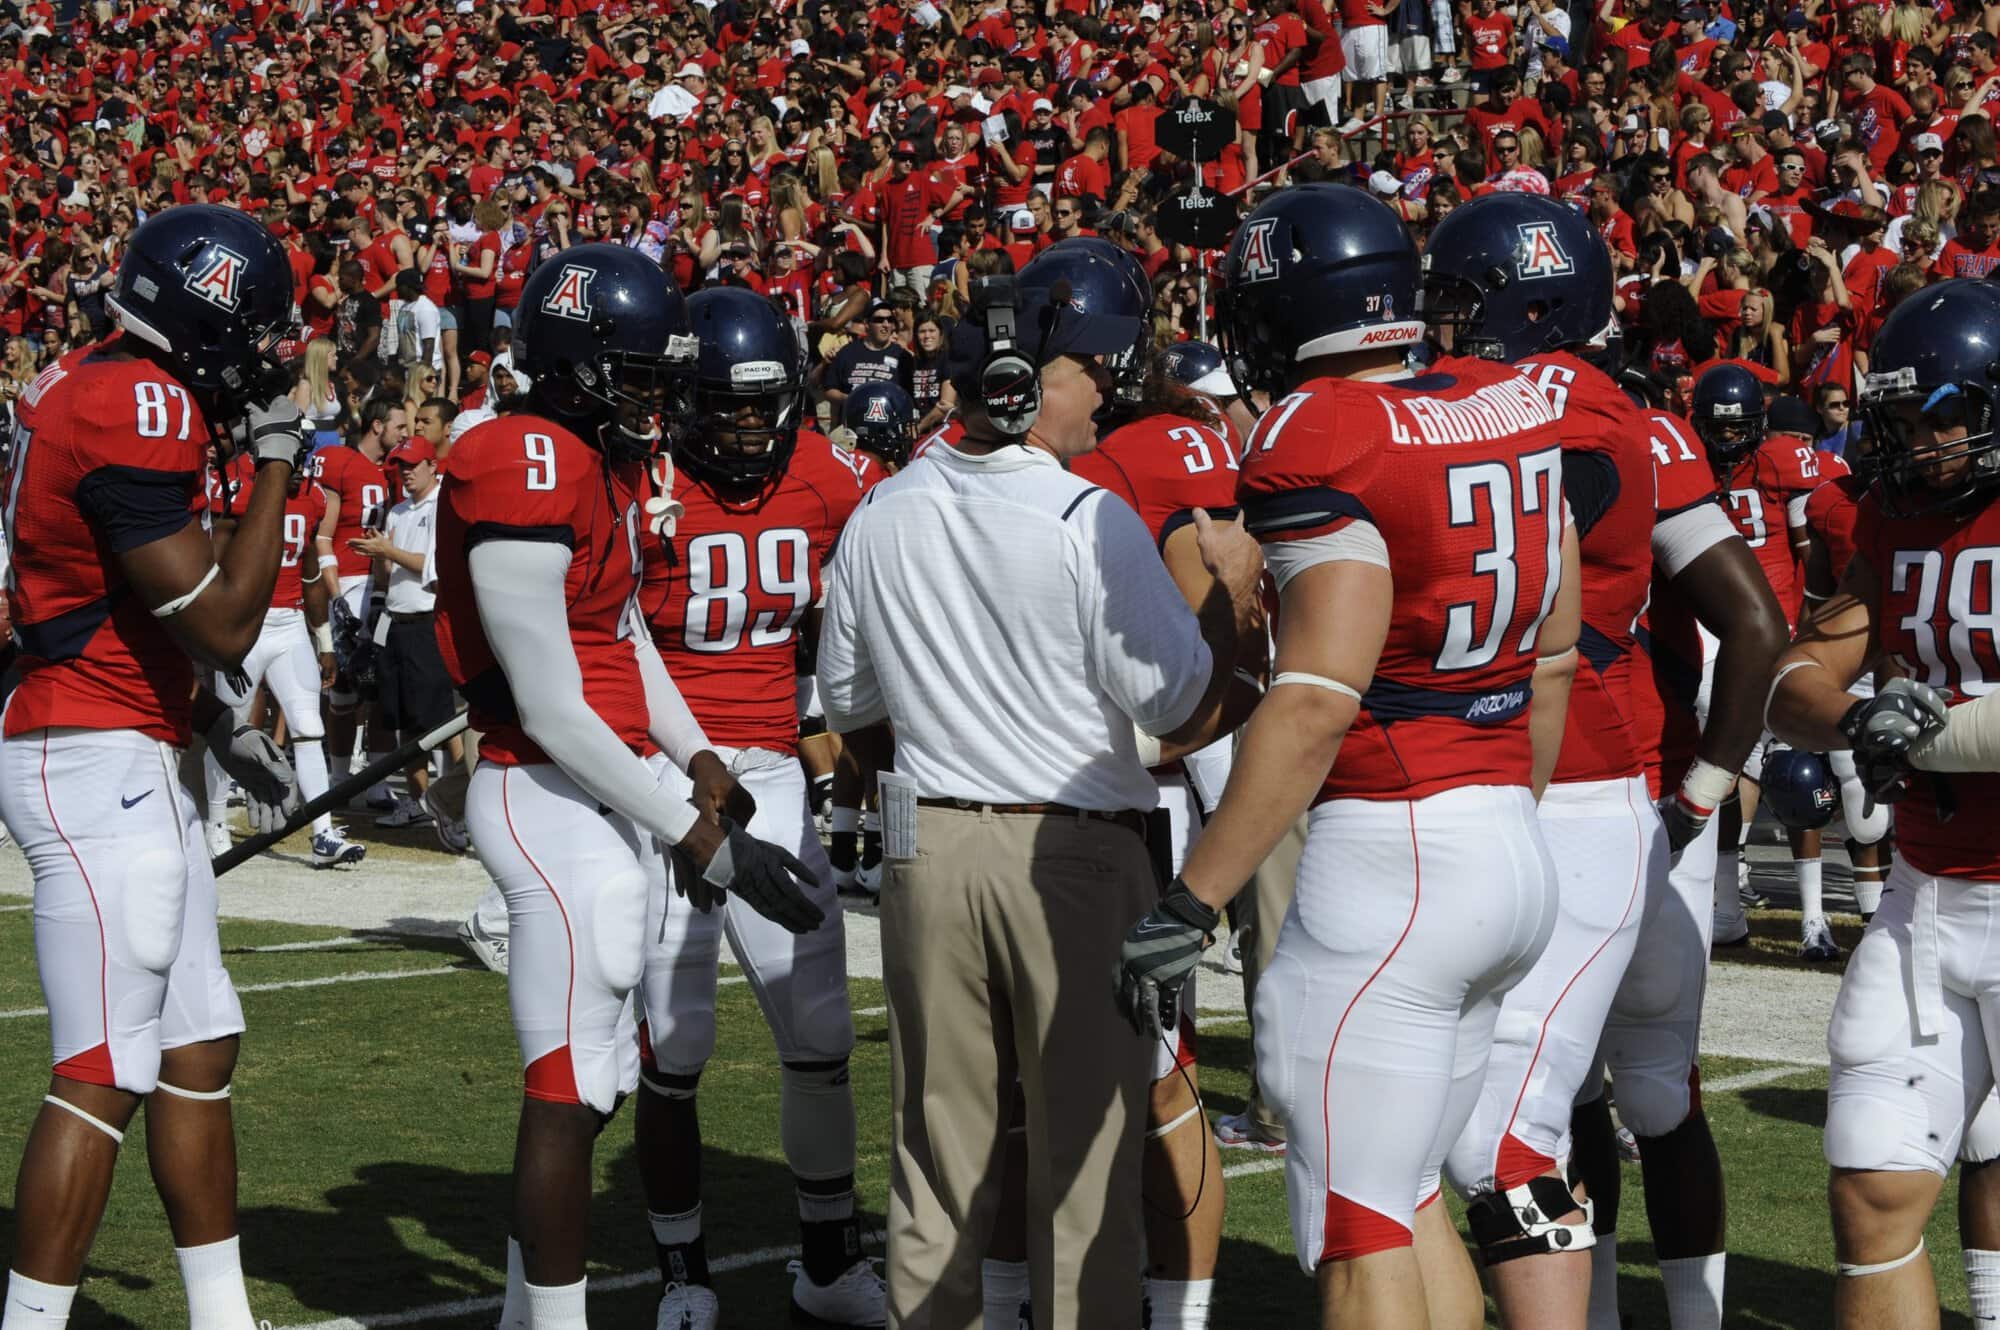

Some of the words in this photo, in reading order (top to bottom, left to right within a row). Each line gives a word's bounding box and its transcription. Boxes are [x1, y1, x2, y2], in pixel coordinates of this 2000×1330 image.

[1176, 110, 1213, 123] Telex
[1178, 196, 1214, 209] Telex
[184, 244, 248, 314] A
[1239, 217, 1280, 284] A
[1517, 221, 1575, 280] A
[541, 263, 597, 322] A
[1366, 296, 1380, 312] 37
[1359, 327, 1418, 345] ARIZONA
[134, 381, 191, 441] 87
[525, 434, 556, 490] 9
[1434, 448, 1562, 672] 37
[684, 528, 811, 654] 89
[1892, 548, 2000, 698] 38
[1466, 690, 1524, 719] ARIZONA
